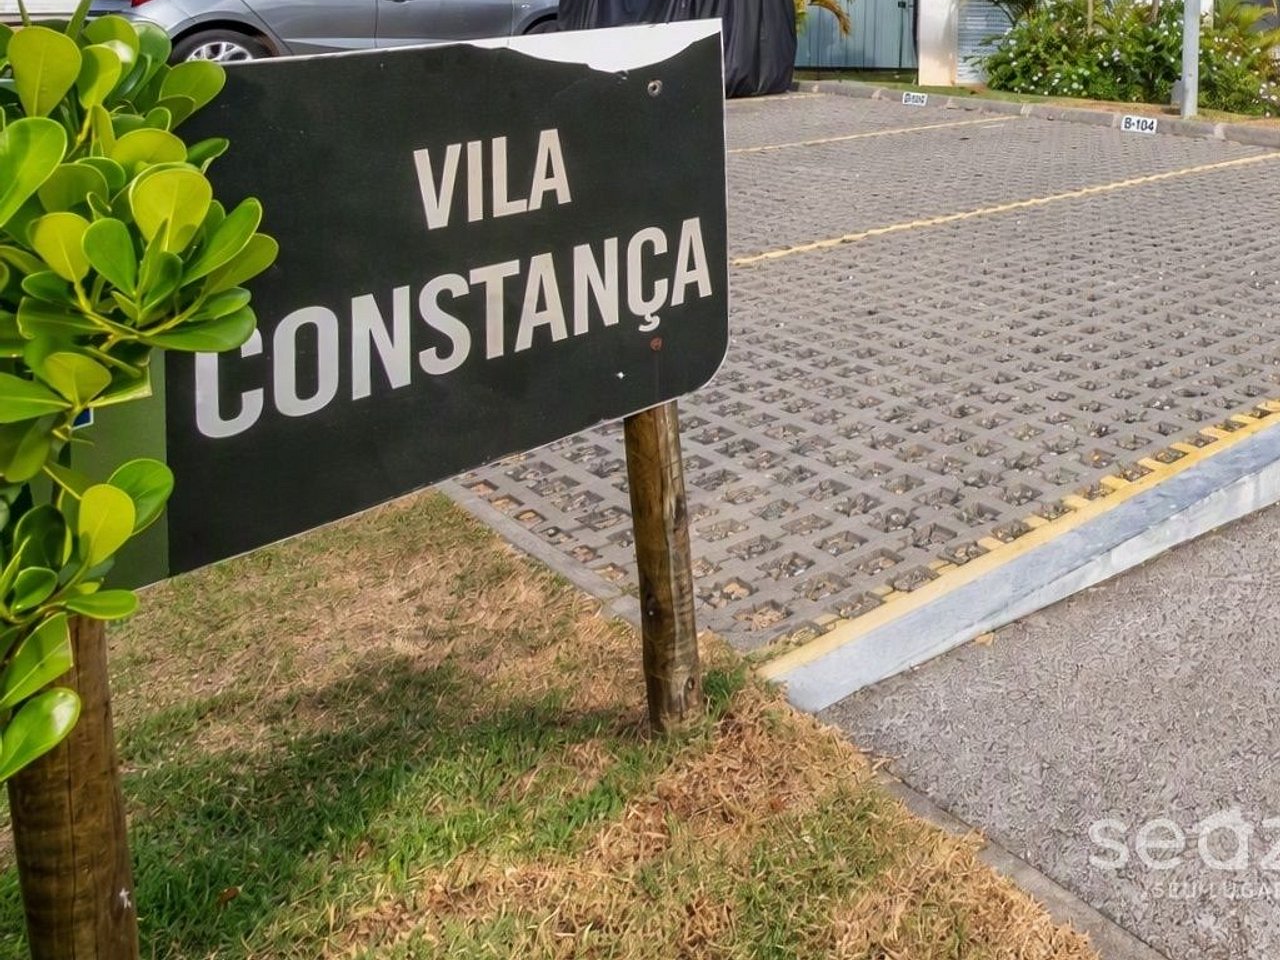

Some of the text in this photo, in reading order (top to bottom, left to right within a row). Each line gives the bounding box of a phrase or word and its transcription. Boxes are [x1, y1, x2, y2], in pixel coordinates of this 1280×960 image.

[1124, 117, 1154, 131] B-104
[413, 127, 572, 229] VILA
[194, 217, 713, 439] CONSTANÇA
